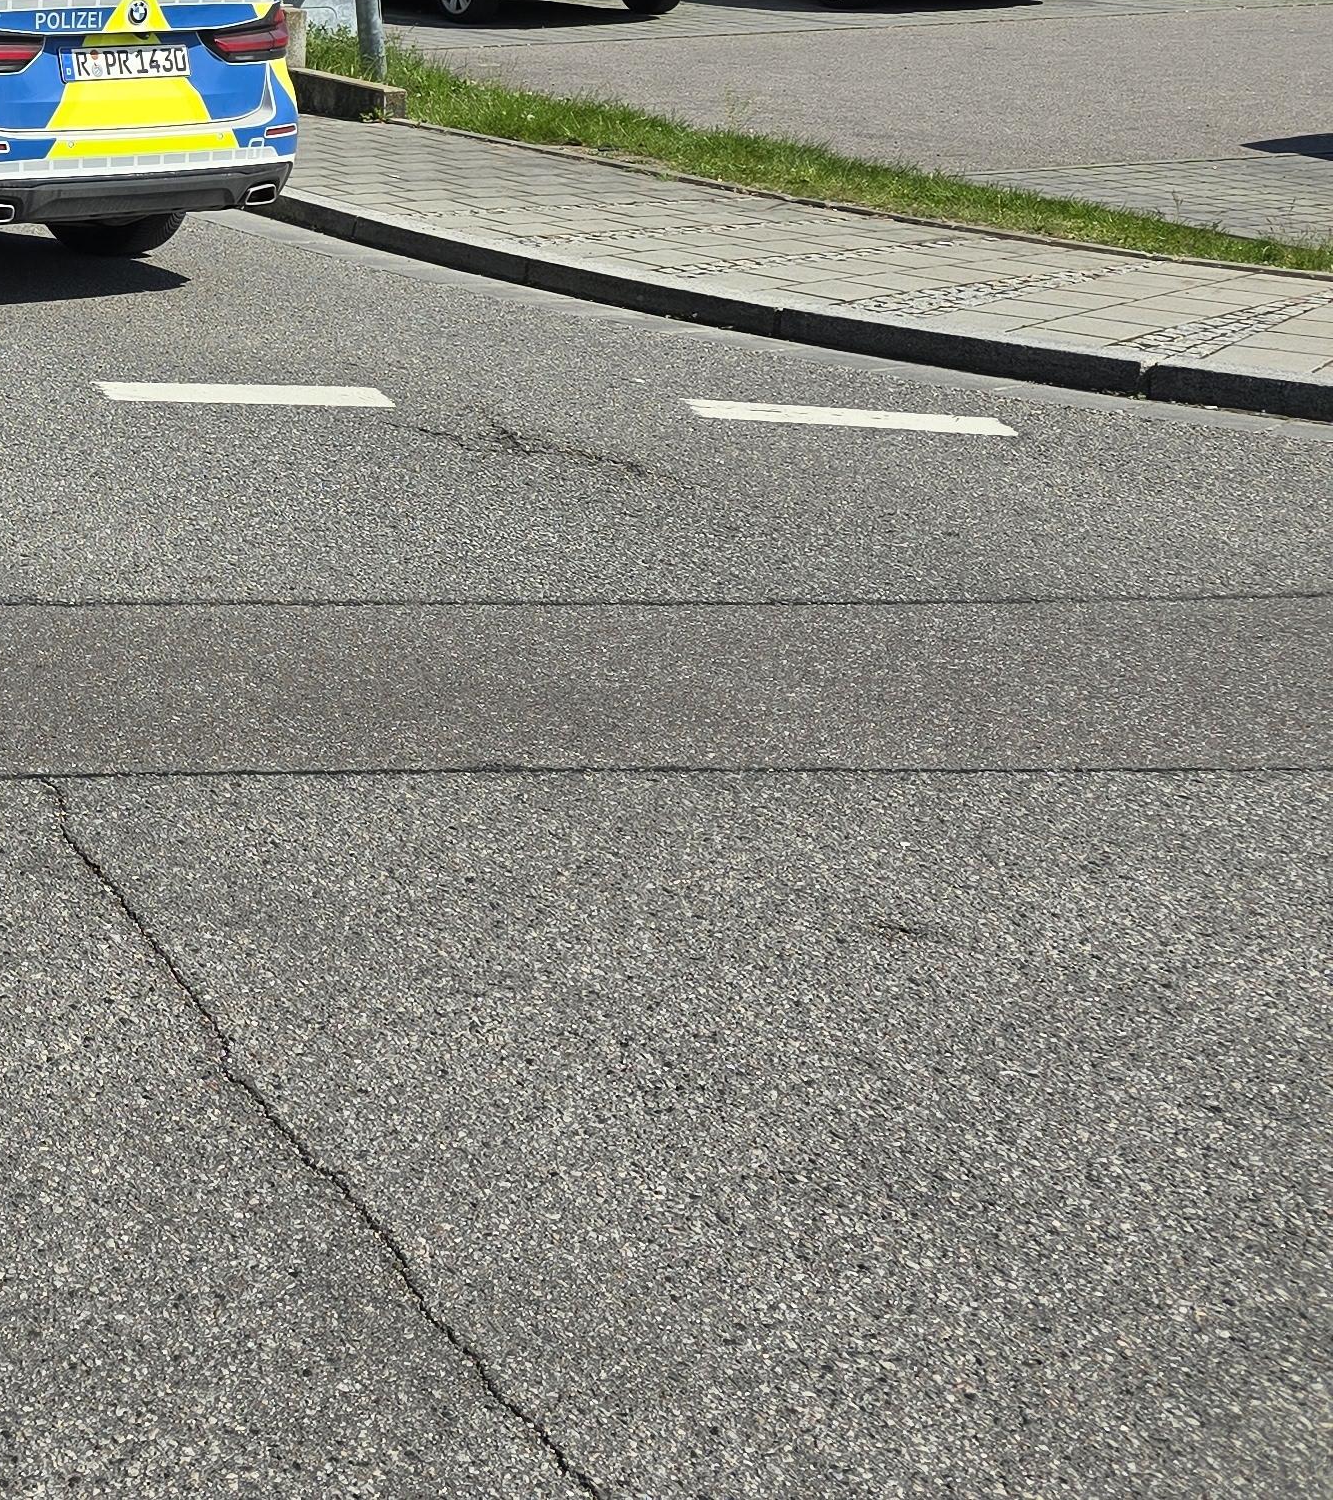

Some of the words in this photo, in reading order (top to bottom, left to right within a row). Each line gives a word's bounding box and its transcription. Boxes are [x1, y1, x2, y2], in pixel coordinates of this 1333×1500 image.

[35, 11, 102, 29] POLIZEI
[76, 51, 90, 76] R
[104, 50, 132, 75] PR
[135, 48, 187, 74] 1430
